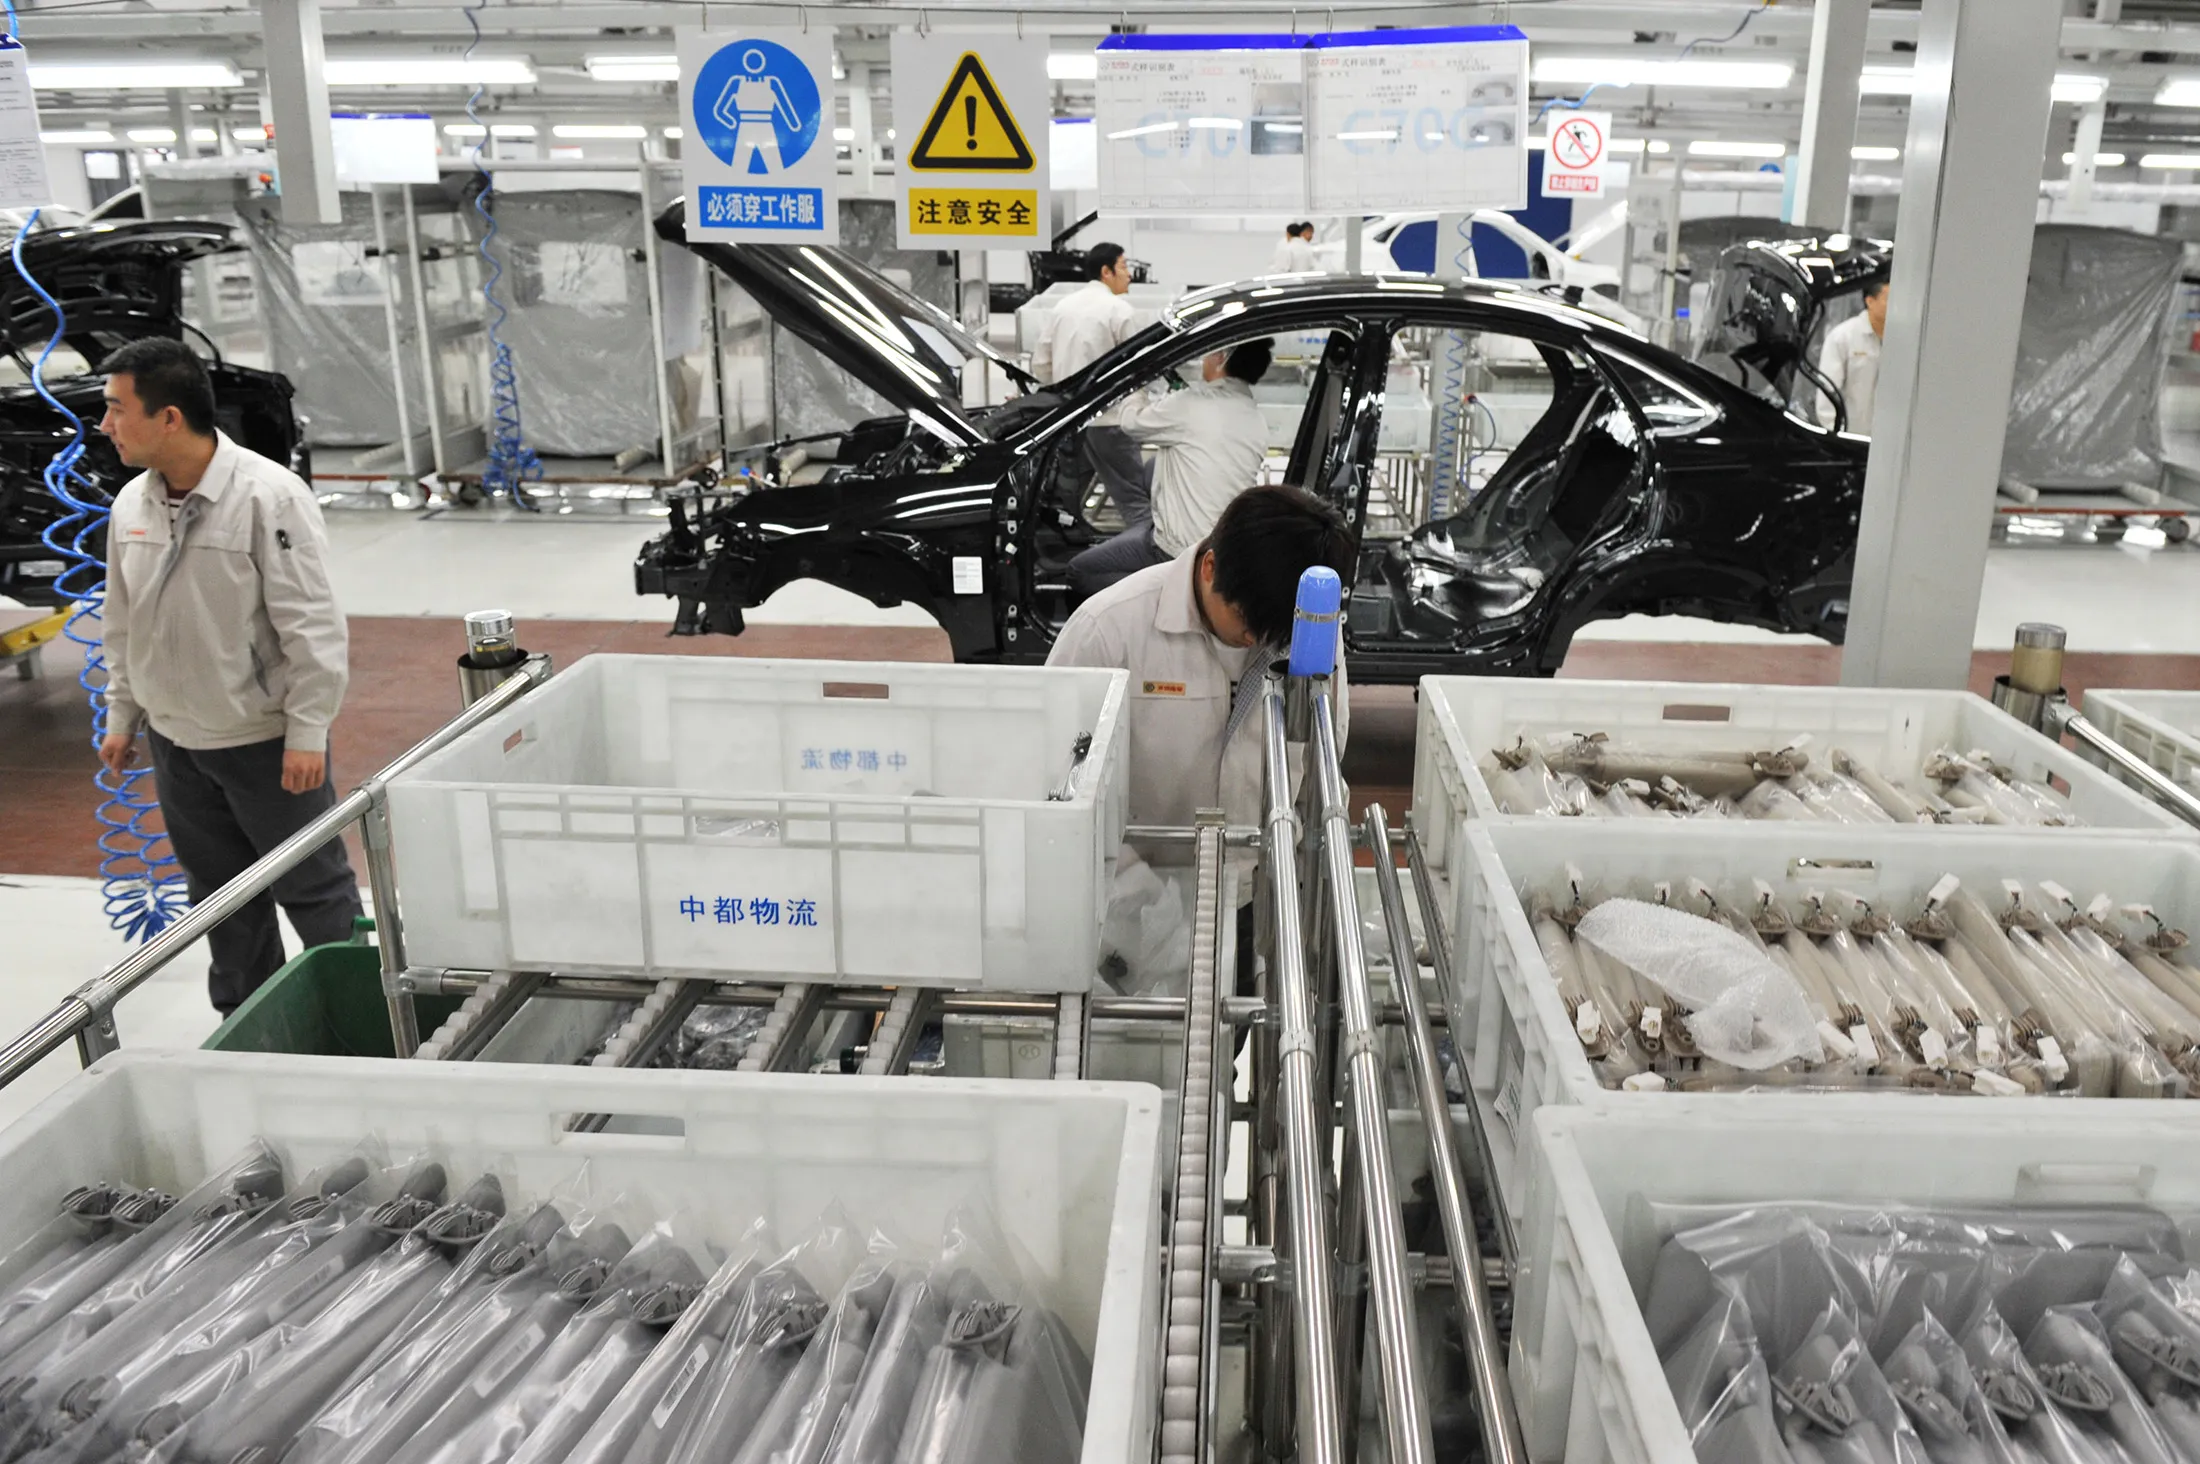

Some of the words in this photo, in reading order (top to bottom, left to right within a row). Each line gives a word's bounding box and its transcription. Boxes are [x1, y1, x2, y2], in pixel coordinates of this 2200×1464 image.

[707, 192, 817, 224] 必须穿工作服
[917, 199, 1032, 226] 注意安全
[679, 895, 818, 927] 中都物流
